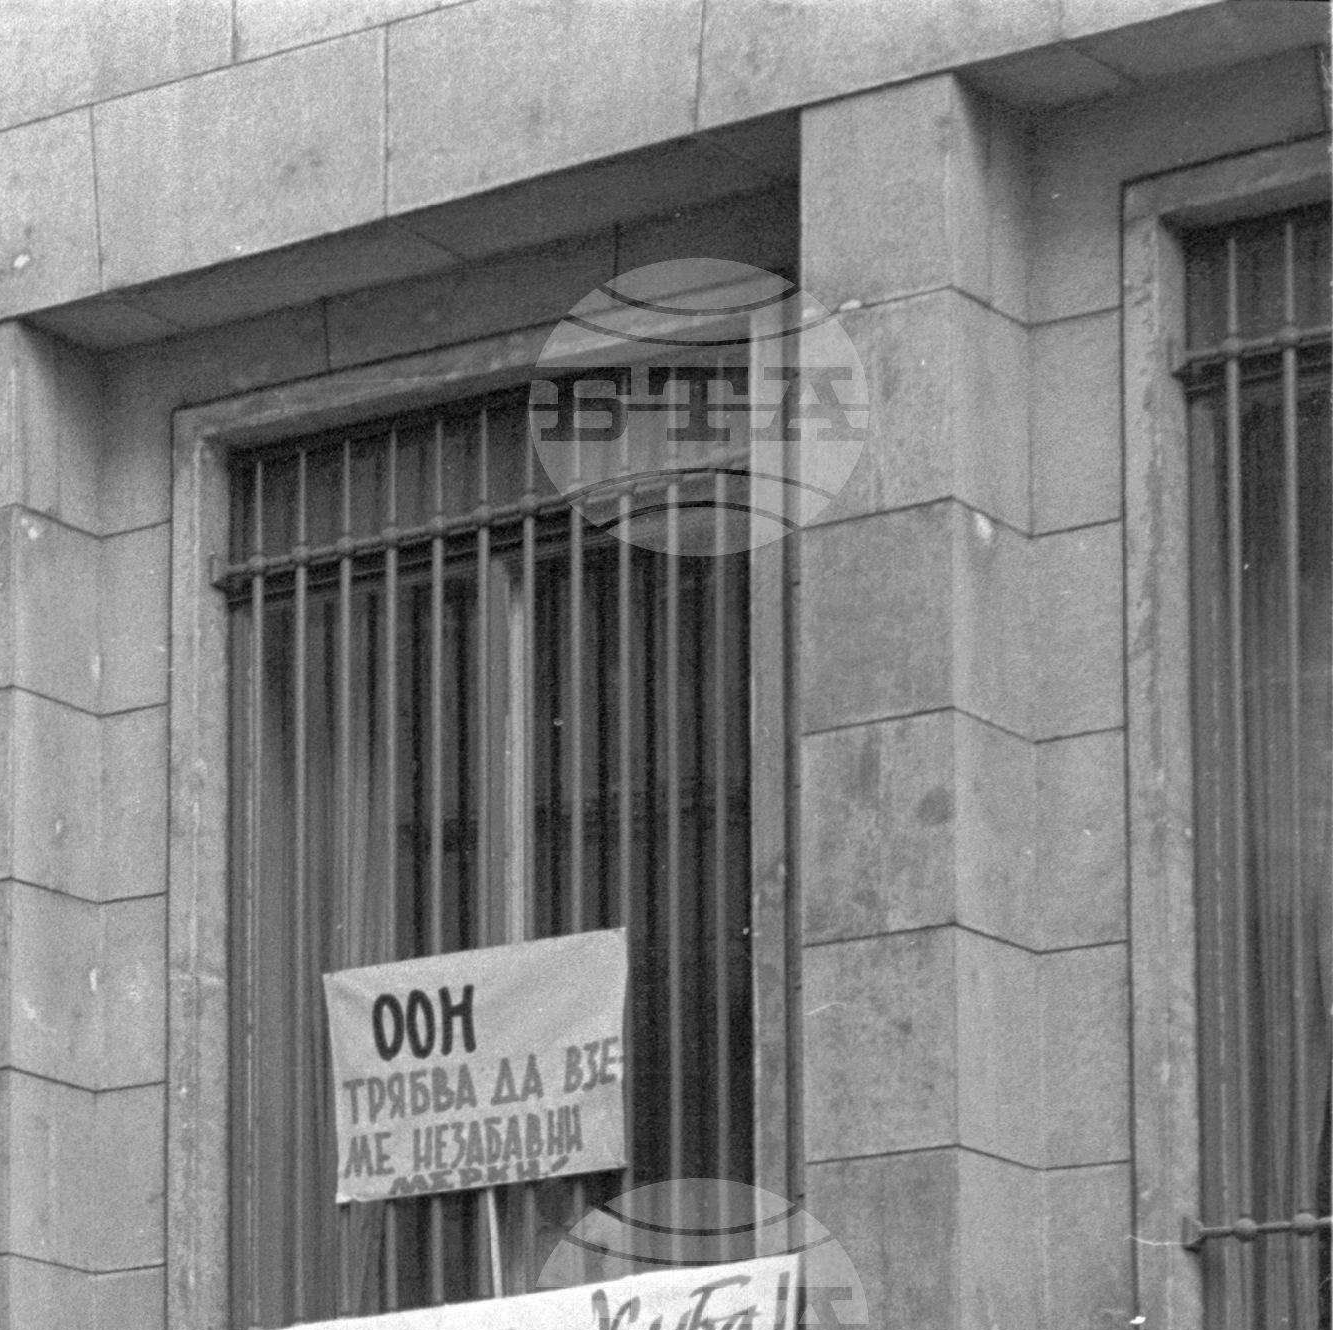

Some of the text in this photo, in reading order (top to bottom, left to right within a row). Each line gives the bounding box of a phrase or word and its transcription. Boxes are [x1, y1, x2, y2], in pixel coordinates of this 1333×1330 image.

[373, 984, 477, 1061] ООН
[343, 1063, 478, 1124] ТРЯБВА
[490, 1053, 544, 1105] ДА
[344, 1104, 583, 1179] МЕ НЕЗАБАВНИ
